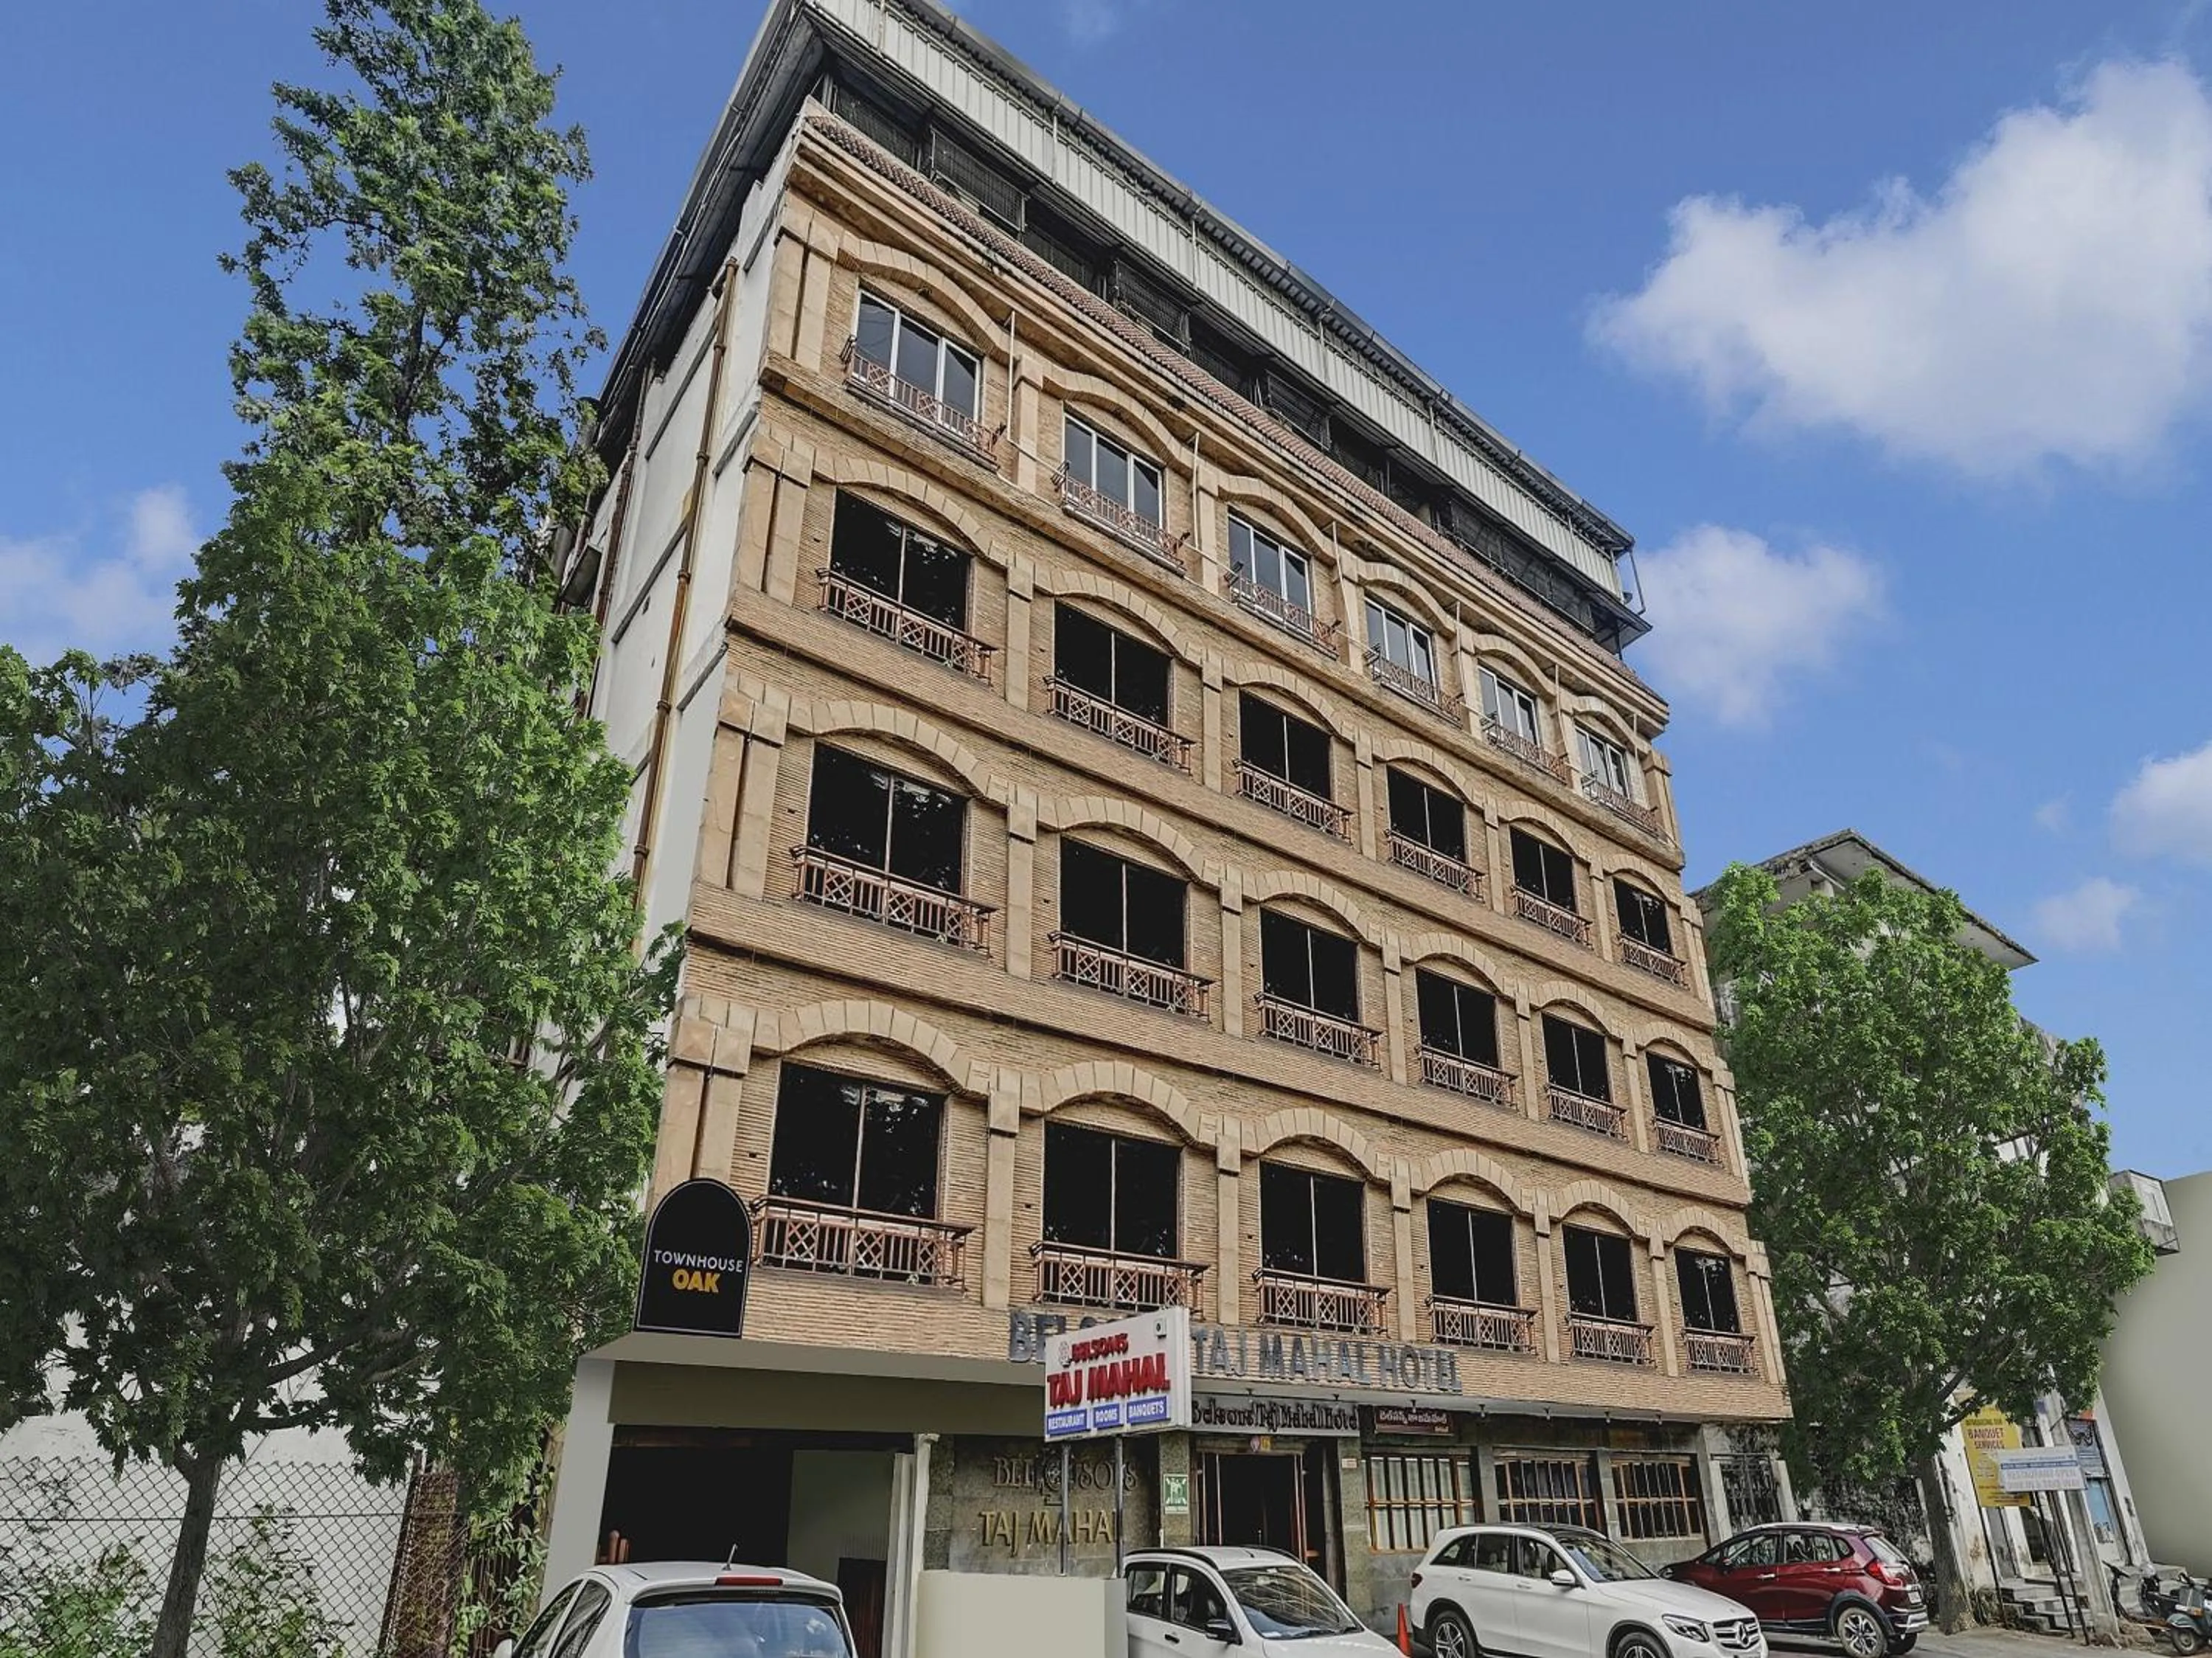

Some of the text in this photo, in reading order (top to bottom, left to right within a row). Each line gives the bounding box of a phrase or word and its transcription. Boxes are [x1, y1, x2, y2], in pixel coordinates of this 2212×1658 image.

[654, 1249, 744, 1272] TOWNHOUSE
[672, 1269, 720, 1293] OAK
[1192, 1325, 1463, 1392] TAJ MAHAL HOTEL
[1047, 1353, 1171, 1409] TAJ MAHAL
[1095, 1408, 1119, 1423] ROOMS
[1129, 1401, 1165, 1418] BANQUETS
[1048, 1412, 1086, 1431] RESTAURANT
[1968, 1427, 2004, 1439] BANQUET
[1974, 1440, 2006, 1449] SERVICES
[978, 1510, 1019, 1558] TAJ
